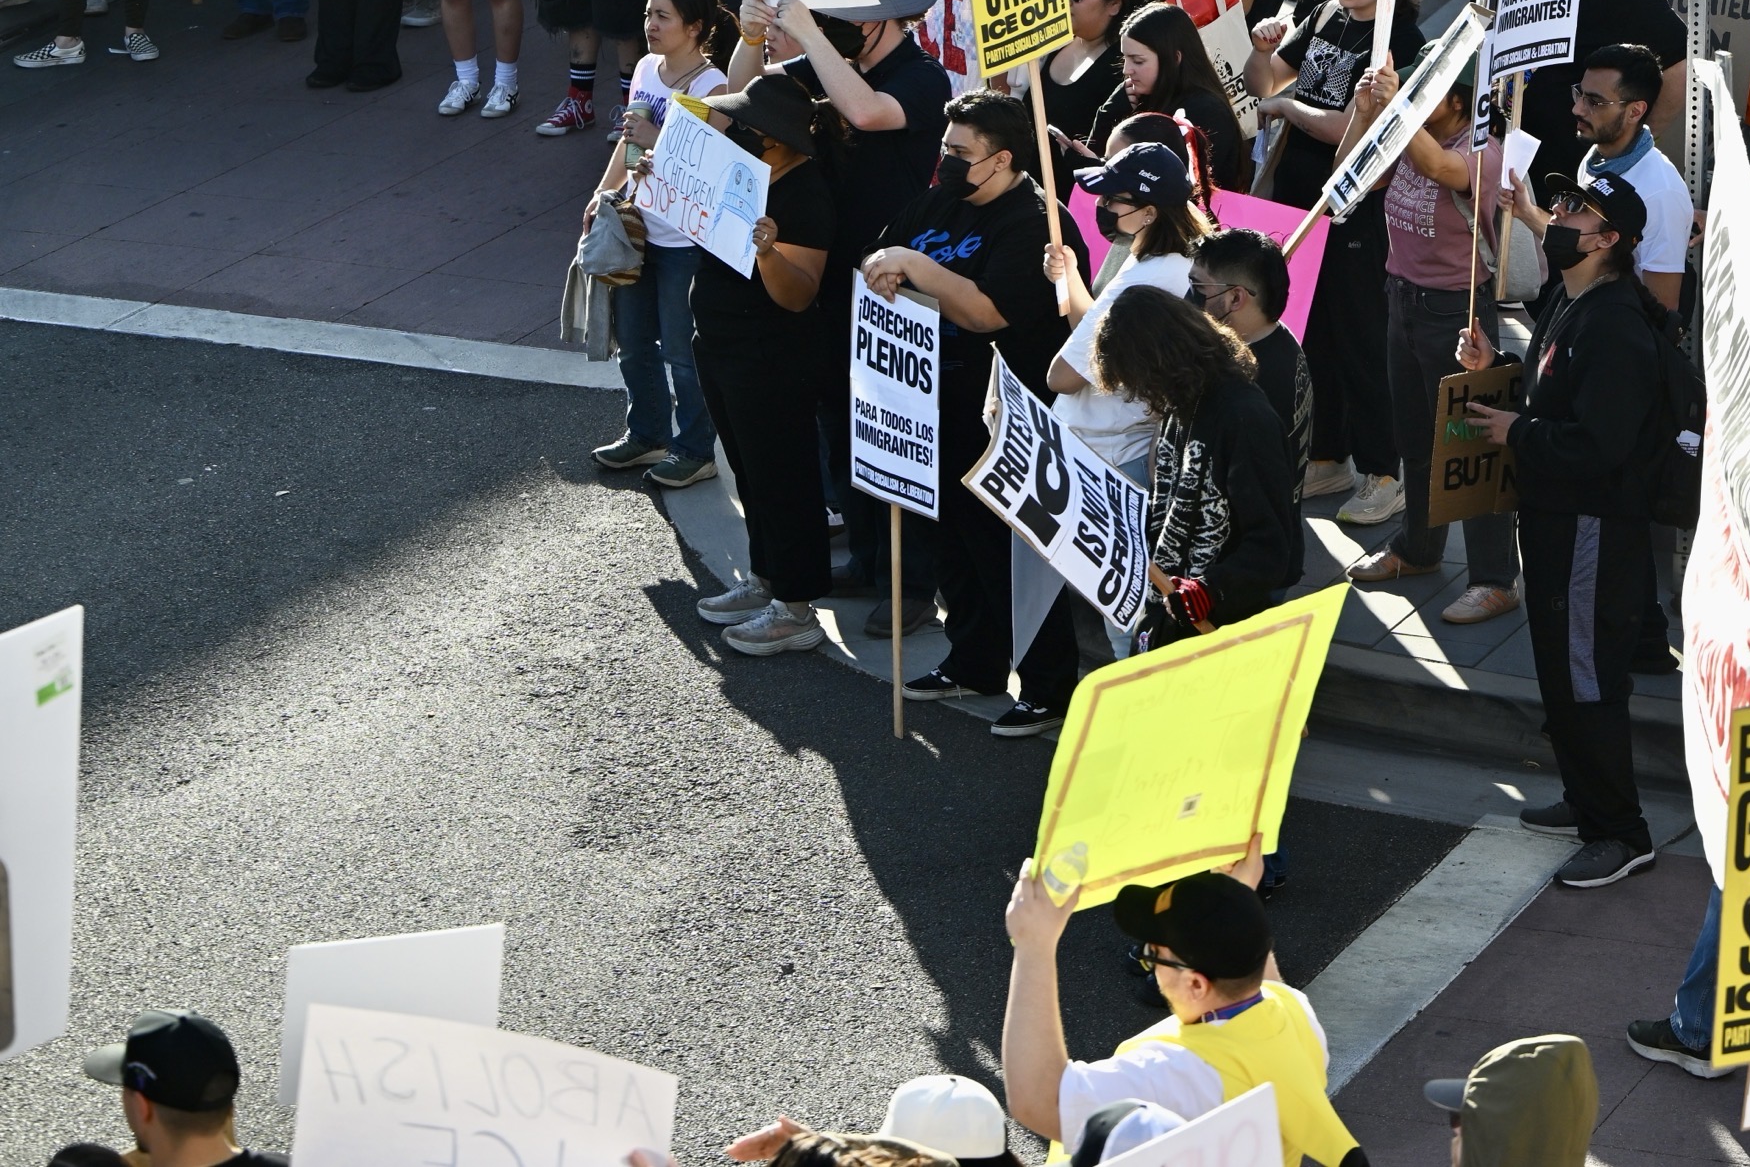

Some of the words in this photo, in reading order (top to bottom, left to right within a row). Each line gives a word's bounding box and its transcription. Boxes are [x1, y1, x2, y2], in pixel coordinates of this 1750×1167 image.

[981, 11, 1019, 44] ICE
[640, 169, 677, 219] STOP
[678, 197, 709, 243] ICE
[858, 298, 934, 353] ¡DERECHOS
[856, 325, 933, 395] PLENOS
[855, 397, 878, 424] PARA
[880, 408, 913, 436] TODOS
[915, 421, 934, 445] LOS
[855, 419, 933, 468] INMIGRANTES!
[979, 360, 1034, 510] PROTESTING
[1015, 395, 1071, 549] ICE
[1444, 451, 1499, 491] BUT
[1077, 470, 1109, 538] NOT
[1072, 521, 1107, 569] IS
[1097, 468, 1130, 606] CRIME!
